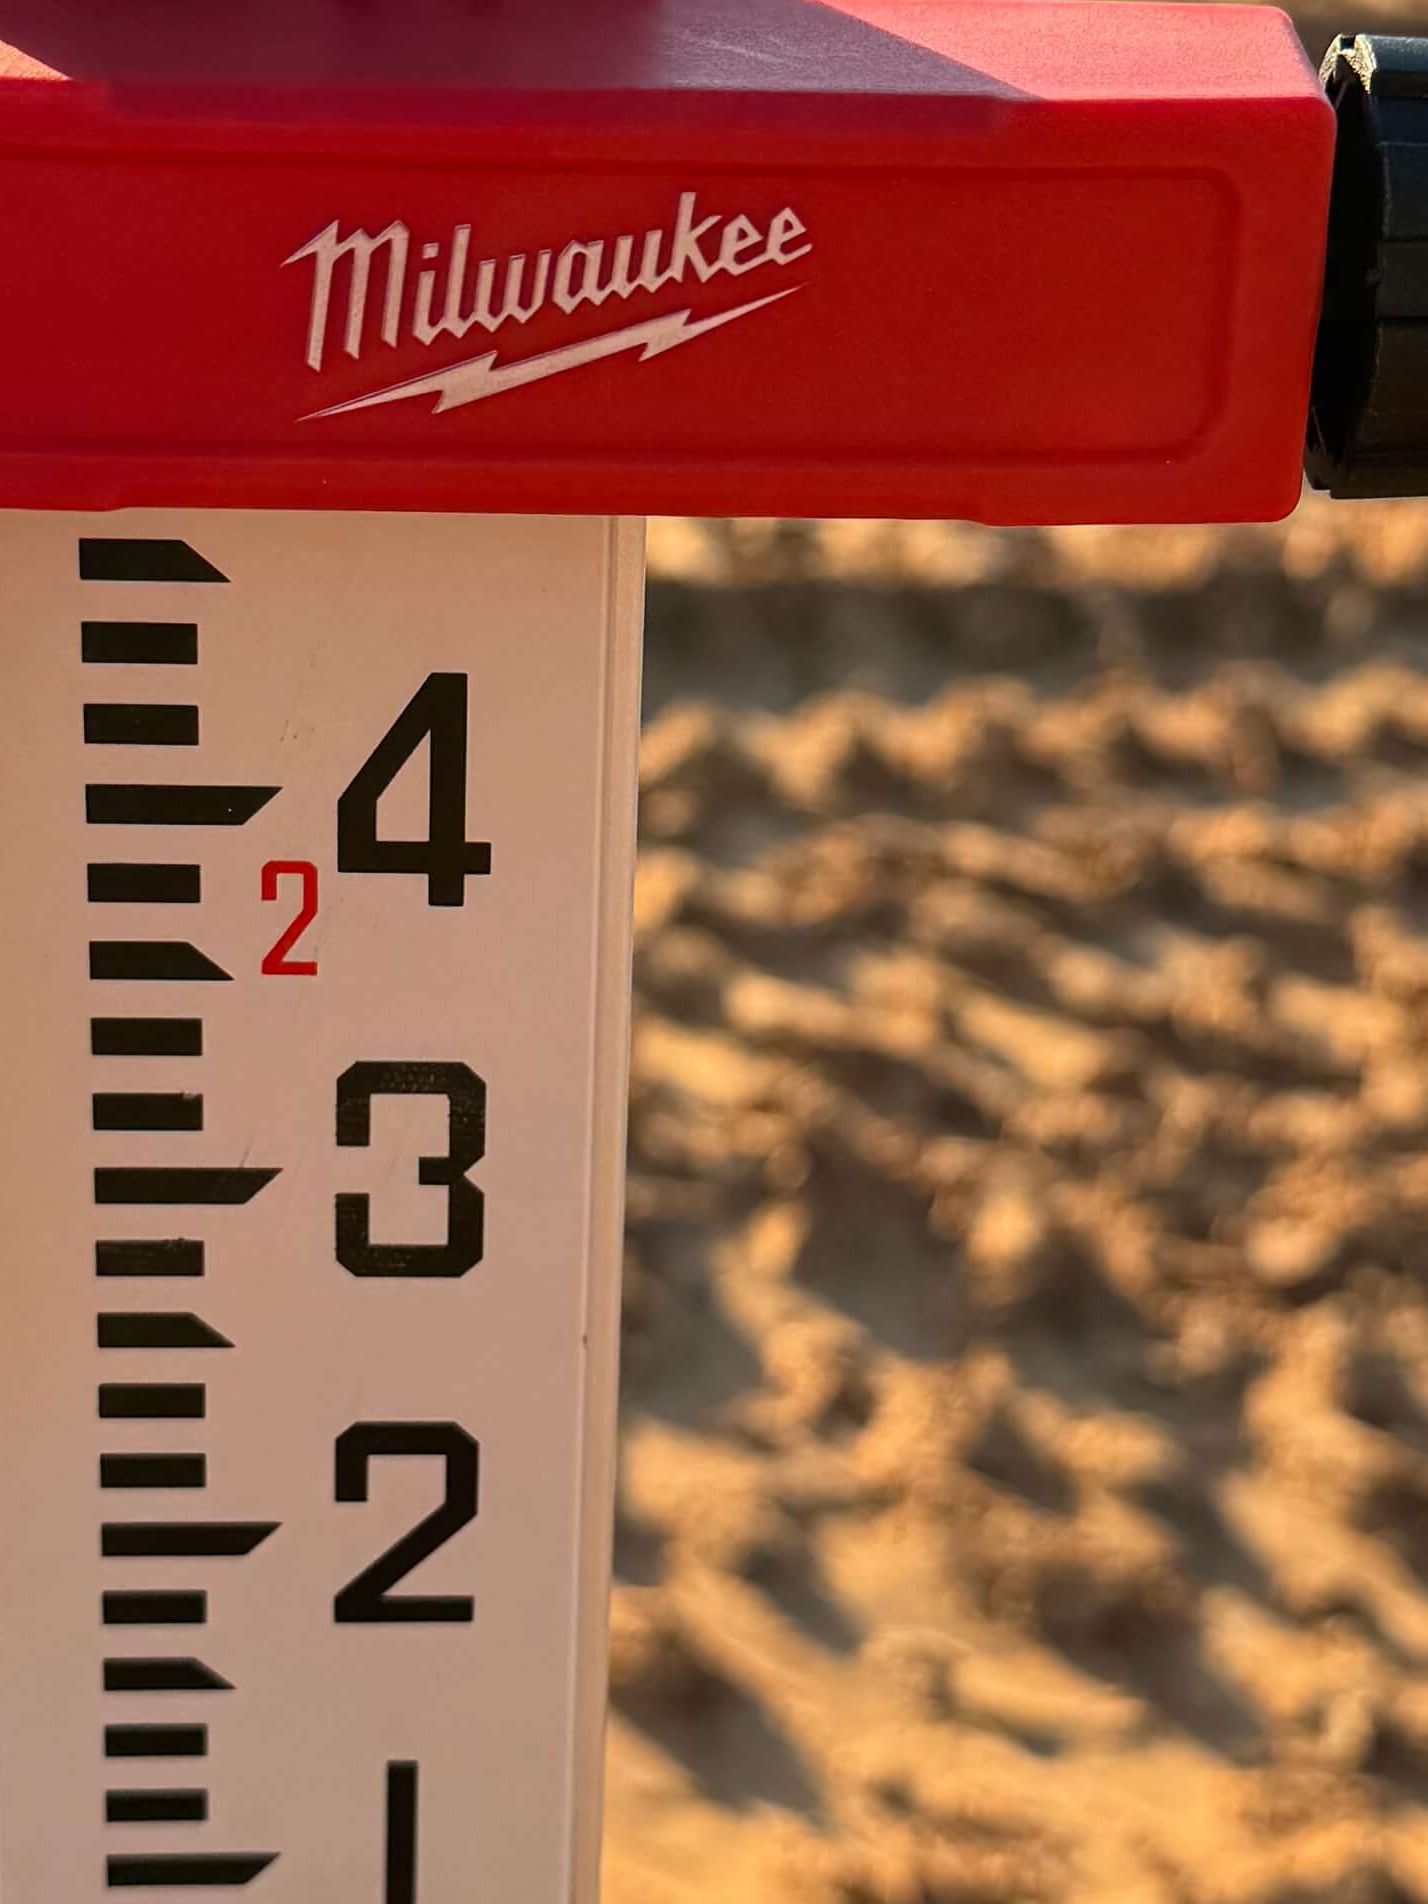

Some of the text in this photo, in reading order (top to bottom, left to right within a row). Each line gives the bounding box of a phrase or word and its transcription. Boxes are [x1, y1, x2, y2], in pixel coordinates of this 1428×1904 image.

[280, 191, 813, 372] Milwaukee
[336, 671, 492, 908] 4
[260, 859, 319, 977] 2
[334, 1060, 487, 1279] 3
[332, 1421, 480, 1625] 2
